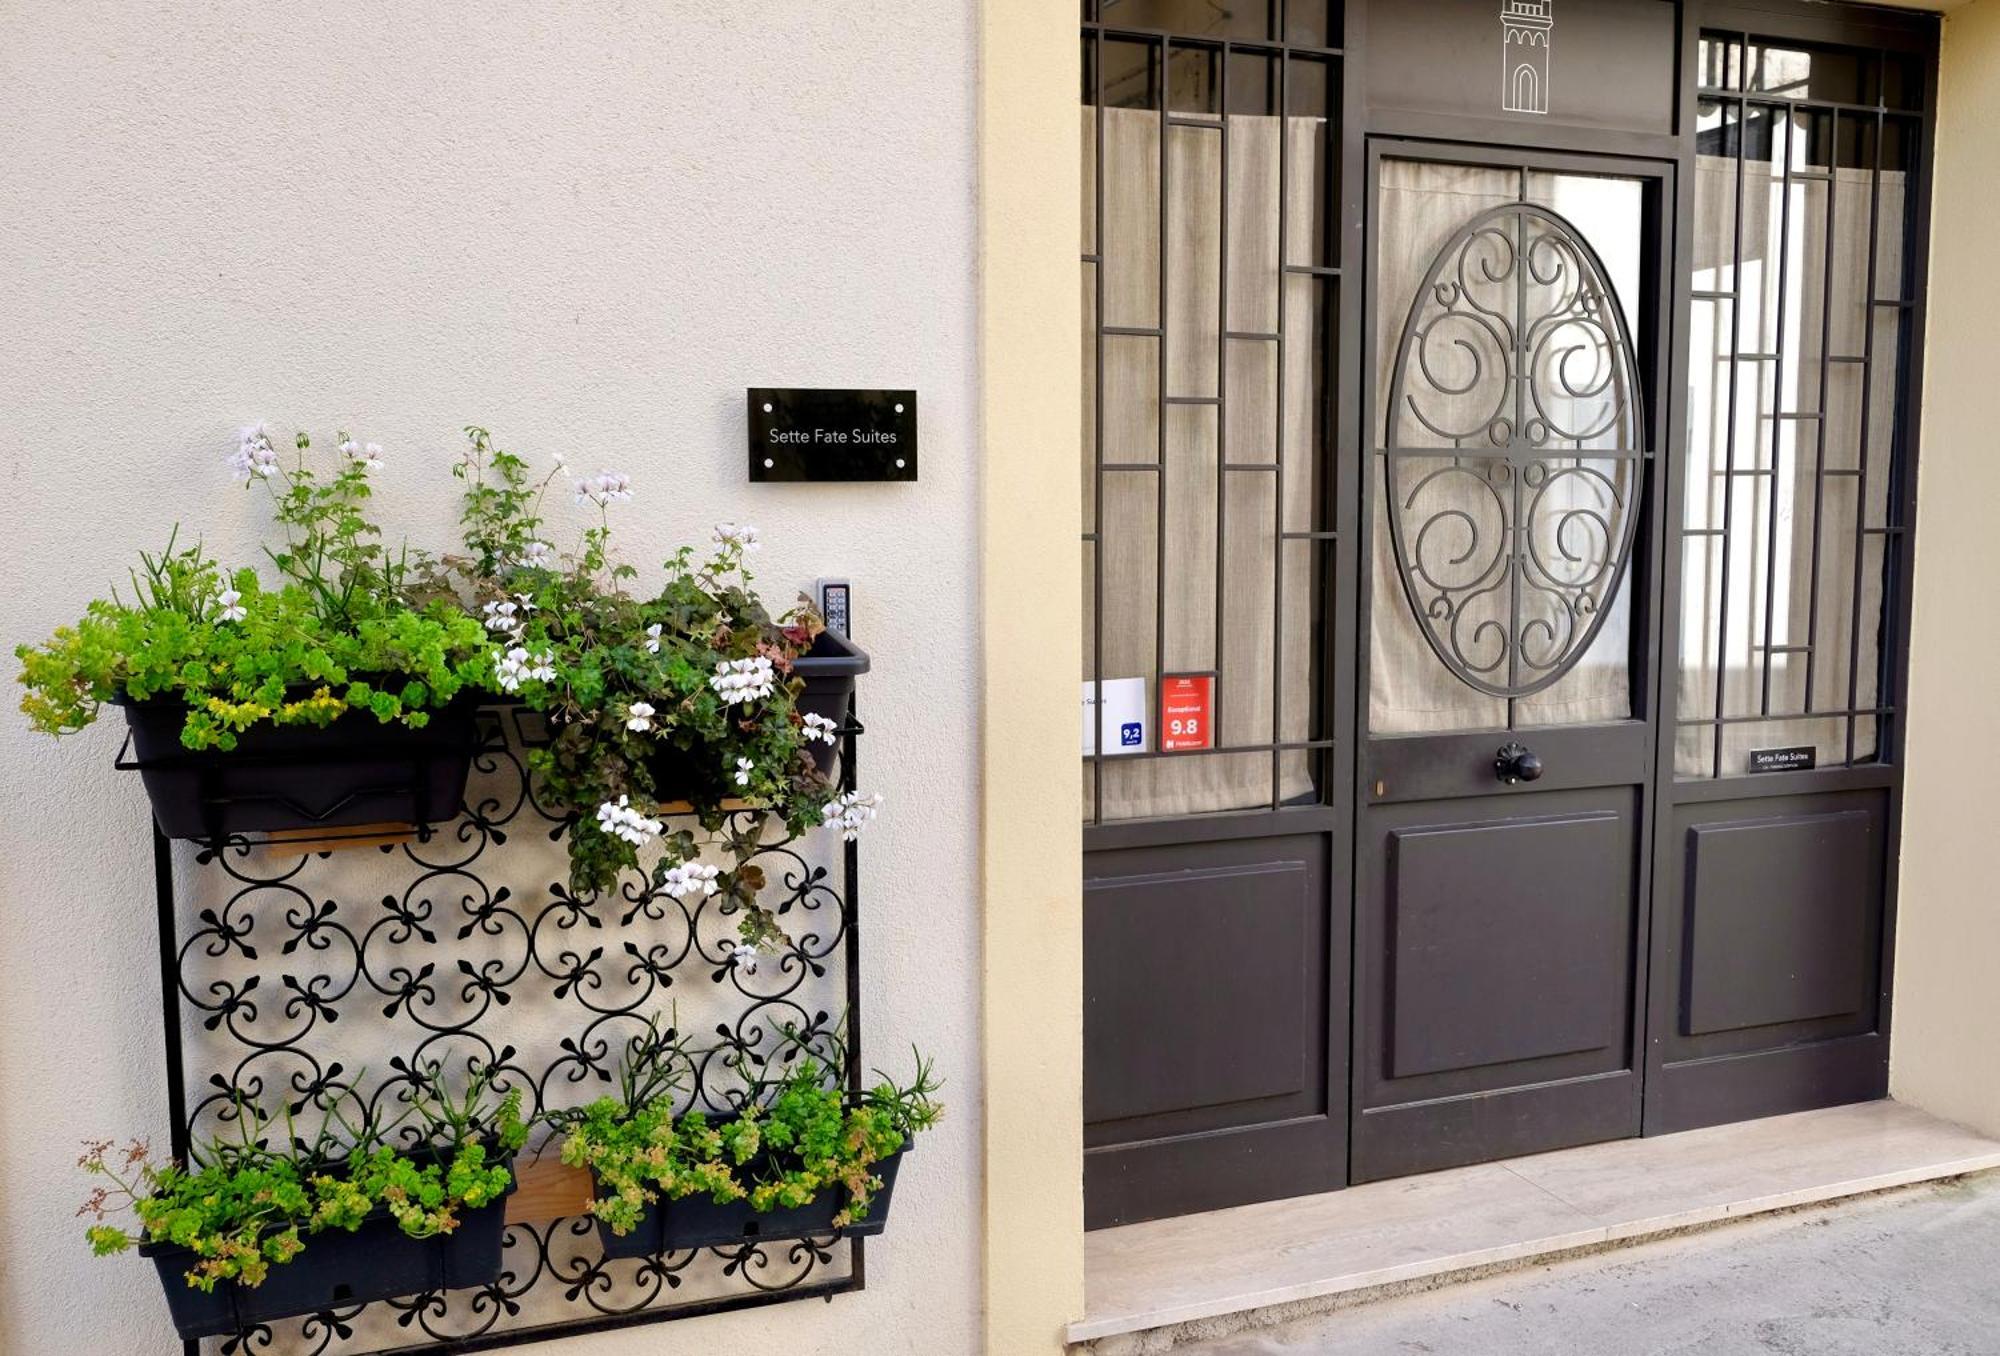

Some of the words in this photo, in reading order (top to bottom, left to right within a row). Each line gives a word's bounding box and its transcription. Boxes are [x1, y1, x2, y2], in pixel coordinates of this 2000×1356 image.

[769, 428, 810, 444] Sette
[815, 428, 848, 444] Fate
[852, 428, 897, 444] Suites
[1123, 728, 1140, 740] 9,2
[1170, 719, 1198, 735] 9.8
